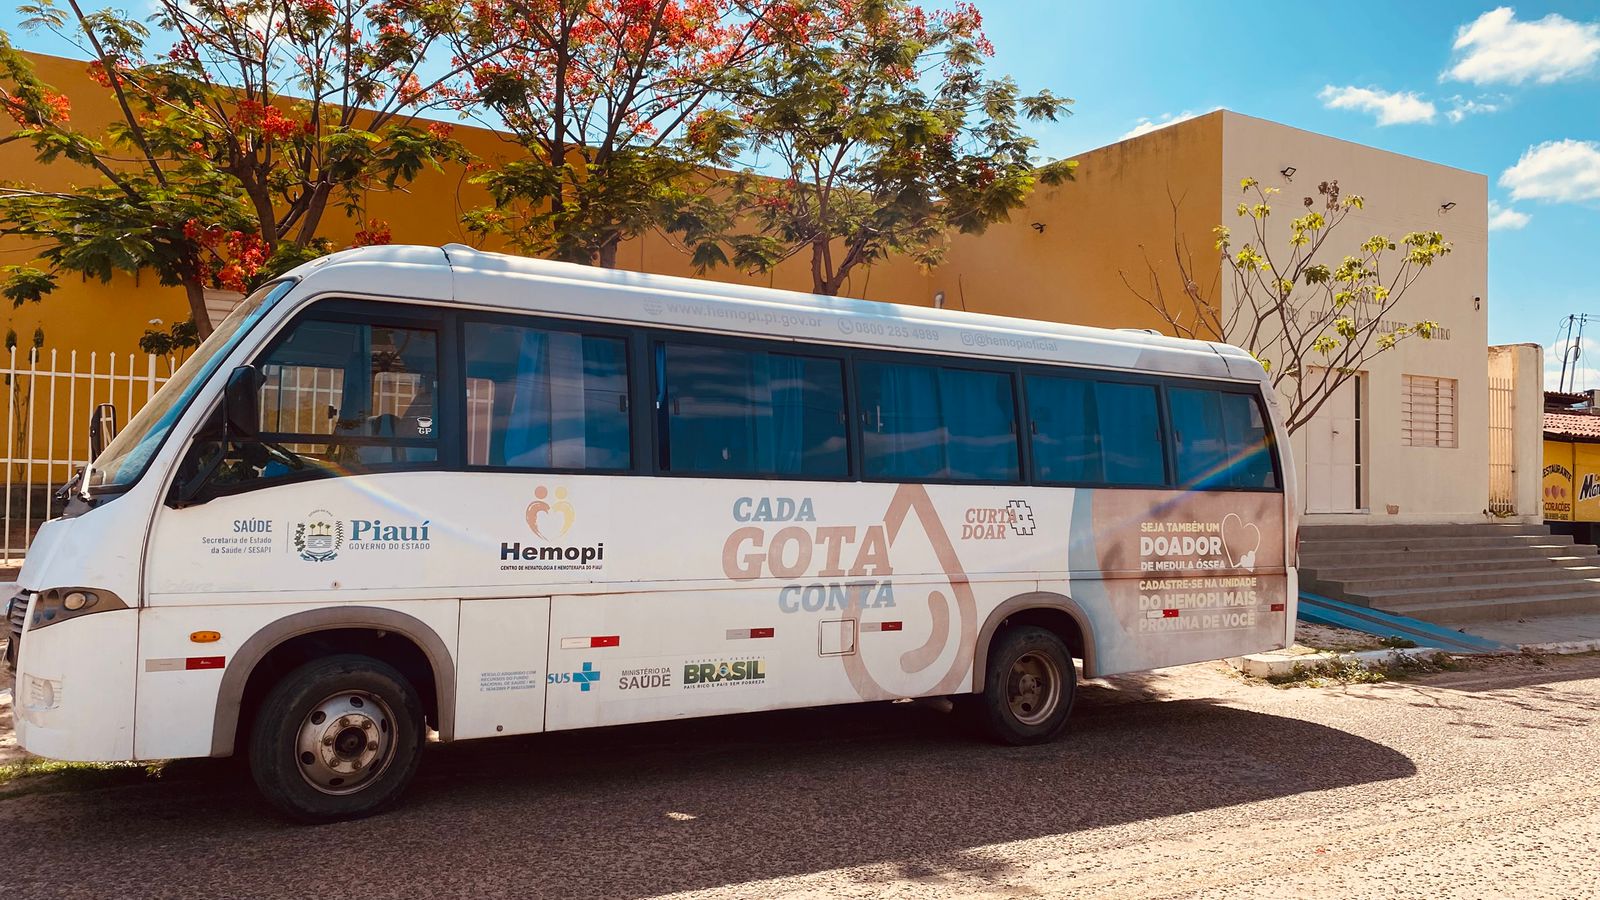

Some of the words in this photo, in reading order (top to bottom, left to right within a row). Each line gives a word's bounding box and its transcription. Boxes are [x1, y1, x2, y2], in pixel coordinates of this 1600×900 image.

[667, 303, 822, 327] www.hemopi.pi.gov.br
[855, 321, 884, 336] 0800
[887, 325, 909, 339] 285
[912, 328, 939, 342] 4989
[975, 332, 1058, 351] @hemopioficial
[1543, 464, 1572, 482] ESTAURANTE
[732, 496, 817, 523] CADA
[965, 507, 1018, 524] CURTA
[233, 517, 273, 533] SAÚDE
[349, 519, 430, 541] Piauí
[961, 524, 1006, 540] DOAR
[1140, 522, 1165, 533] SEJA
[1166, 520, 1205, 532] TAMBÉM
[1206, 522, 1220, 532] UM
[202, 536, 238, 544] Secretaria
[239, 536, 248, 544] de
[249, 536, 272, 544] Estado
[348, 542, 386, 550] GOVERNO
[388, 542, 399, 550] DO
[401, 542, 431, 550] ESTADO
[1140, 536, 1222, 556] DOADOR
[211, 546, 220, 554] da
[248, 546, 272, 554] SESAPI
[500, 542, 604, 565] Hemopi
[721, 525, 894, 582] GOTA
[1140, 561, 1154, 571] DE
[1156, 560, 1194, 571] MEDULA
[1196, 558, 1226, 570] ÓSSEA
[1139, 578, 1203, 591] CADASTRE-SE
[1205, 578, 1217, 589] NA
[1219, 577, 1257, 588] UNIDADE
[778, 579, 897, 614] CONTA
[1139, 594, 1162, 611] DO
[1164, 592, 1220, 610] HEMOPI
[1223, 590, 1257, 607] MAIS
[1202, 614, 1220, 629] DE
[548, 672, 571, 684] SUS
[621, 668, 660, 676] MINISTÉRIO
[683, 660, 766, 684] BRASIL
[618, 674, 671, 690] SAÚDE
